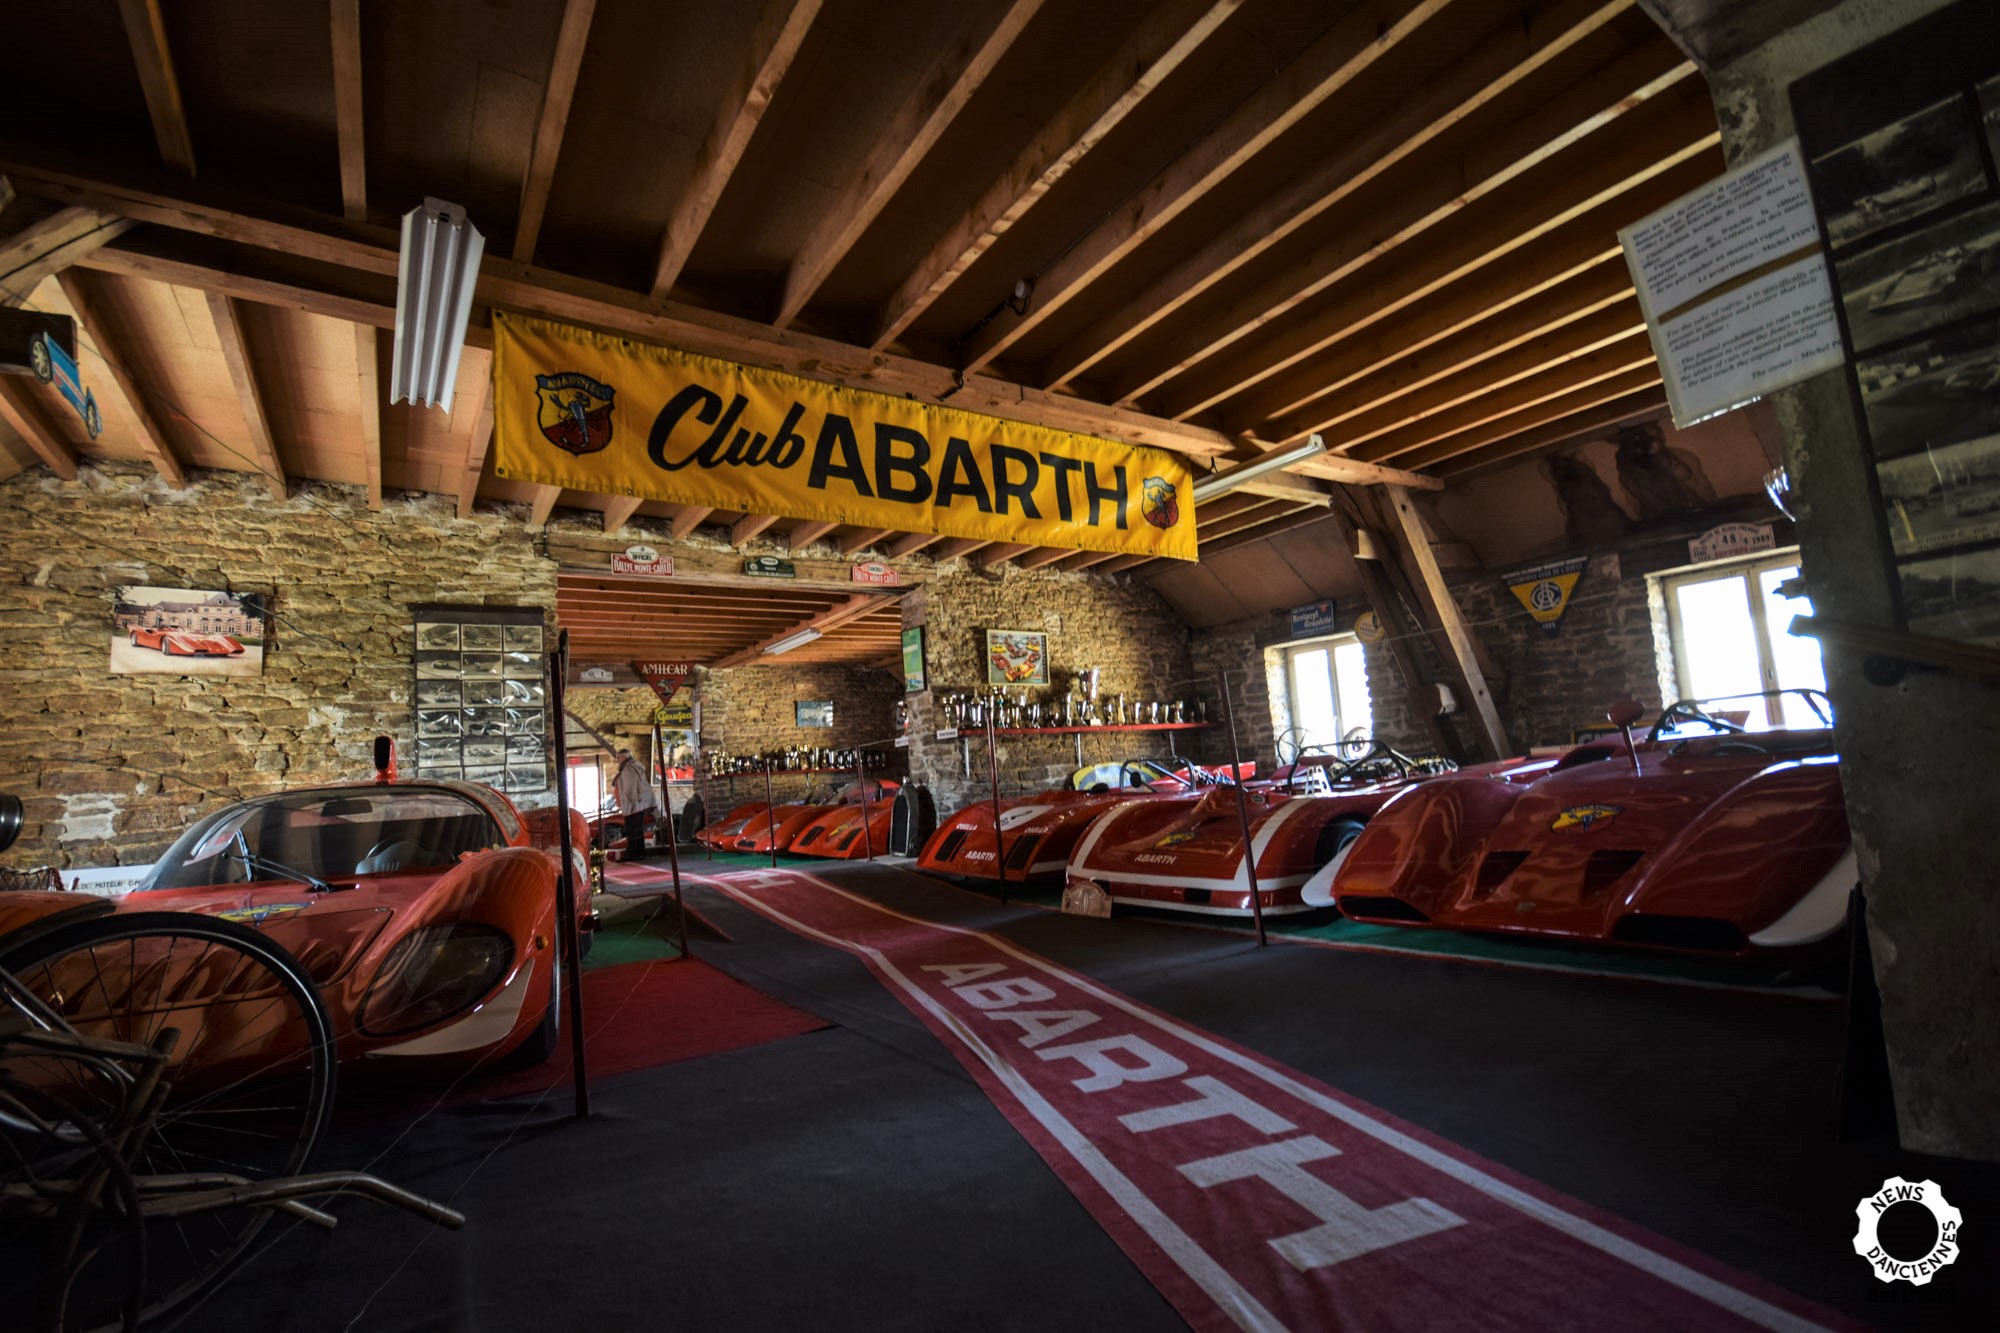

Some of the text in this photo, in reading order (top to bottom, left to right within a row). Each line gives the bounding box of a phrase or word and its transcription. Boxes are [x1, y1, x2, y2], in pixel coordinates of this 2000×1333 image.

[647, 383, 1129, 531] Club ABARTH
[1722, 534, 1737, 544] 48
[614, 559, 635, 573] RALLYE
[657, 710, 692, 724] Peugeo
[964, 849, 996, 862] ABARTH
[1134, 853, 1176, 865] ABARTH
[920, 961, 1469, 1274] ABARTH
